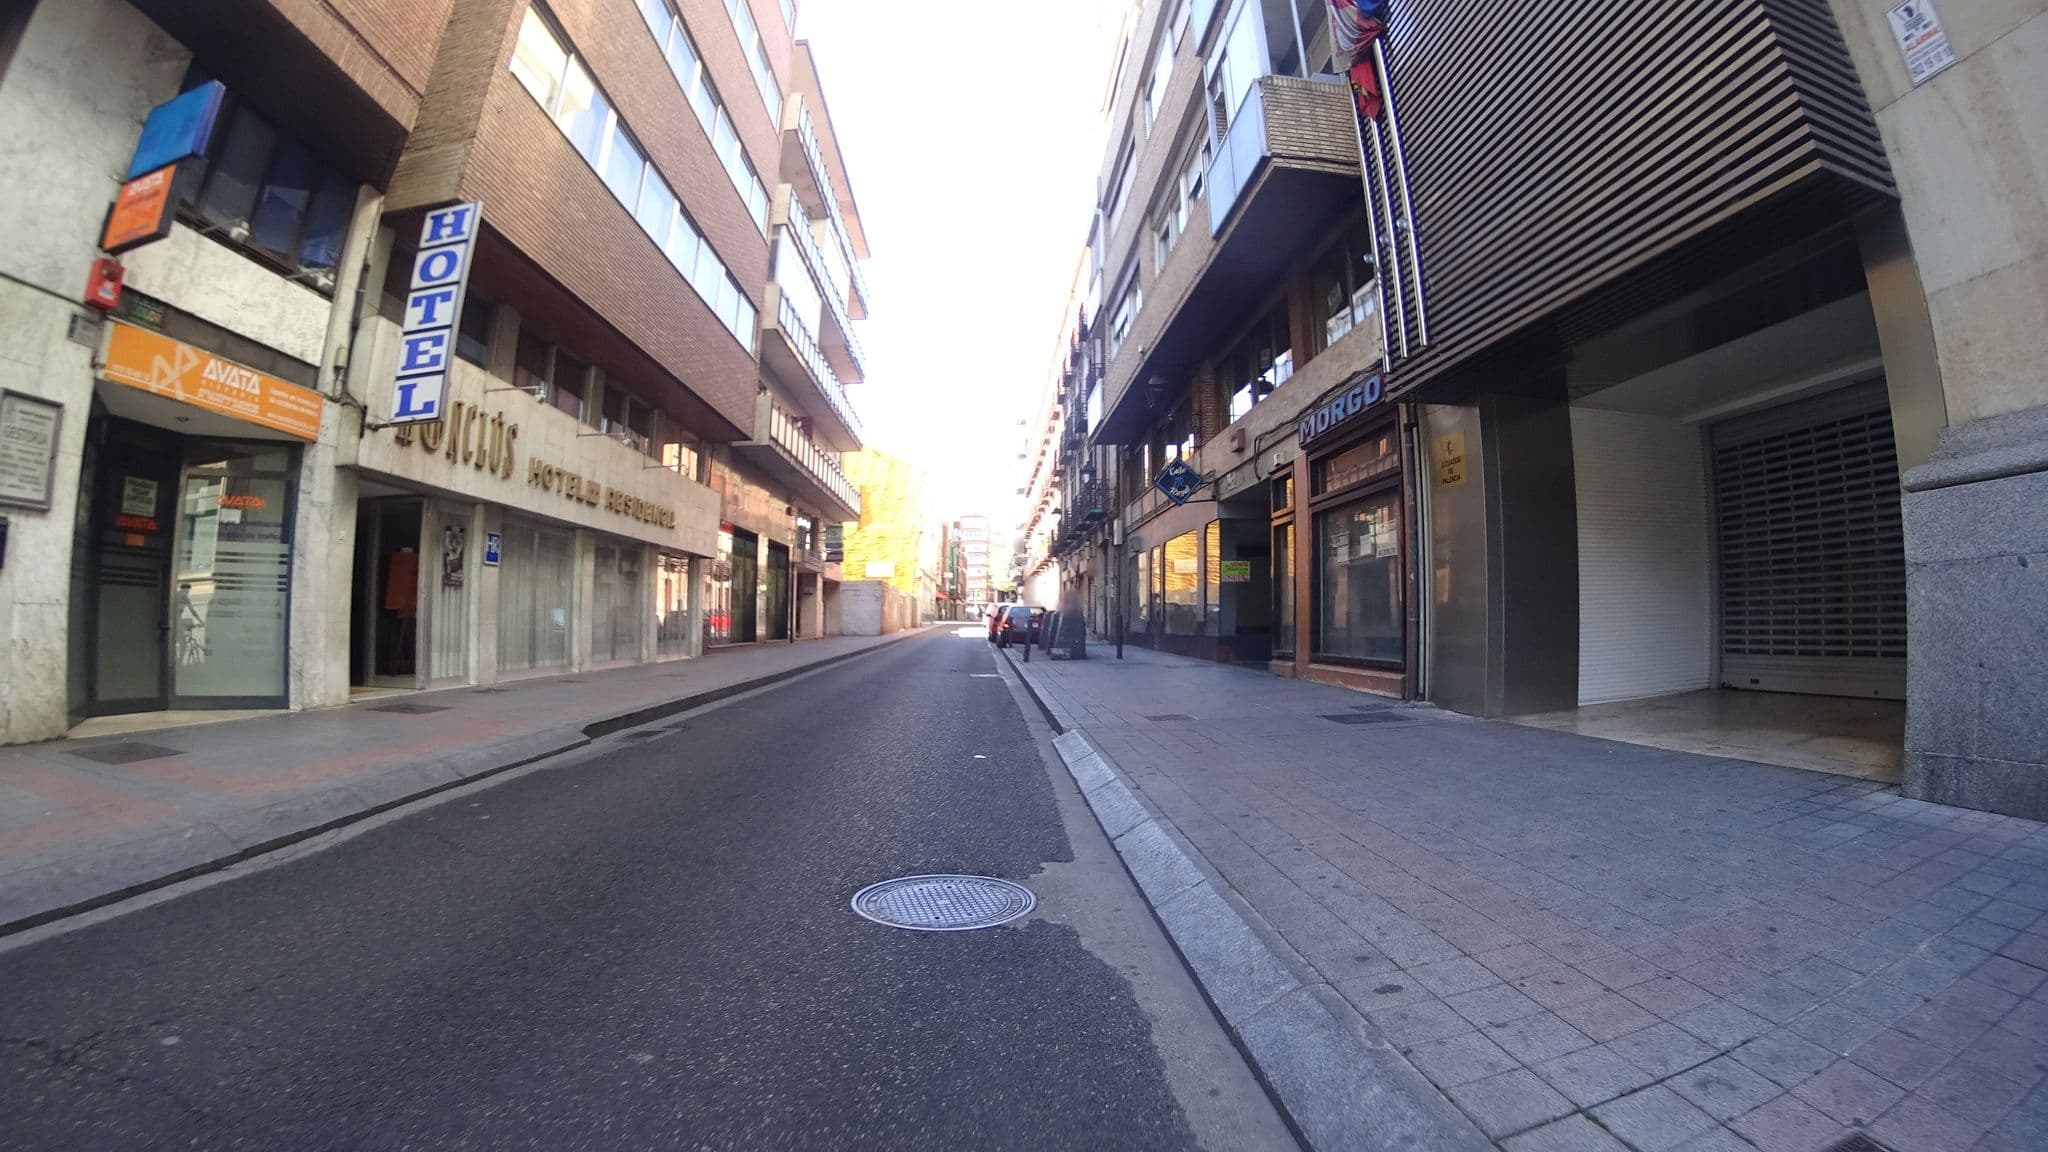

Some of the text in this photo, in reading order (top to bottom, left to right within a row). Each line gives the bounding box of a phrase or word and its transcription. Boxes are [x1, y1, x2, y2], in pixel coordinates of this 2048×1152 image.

[395, 208, 471, 418] HOTEL
[202, 358, 262, 396] AVATA
[1299, 375, 1382, 444] MORGO
[527, 457, 585, 503] HOTEL
